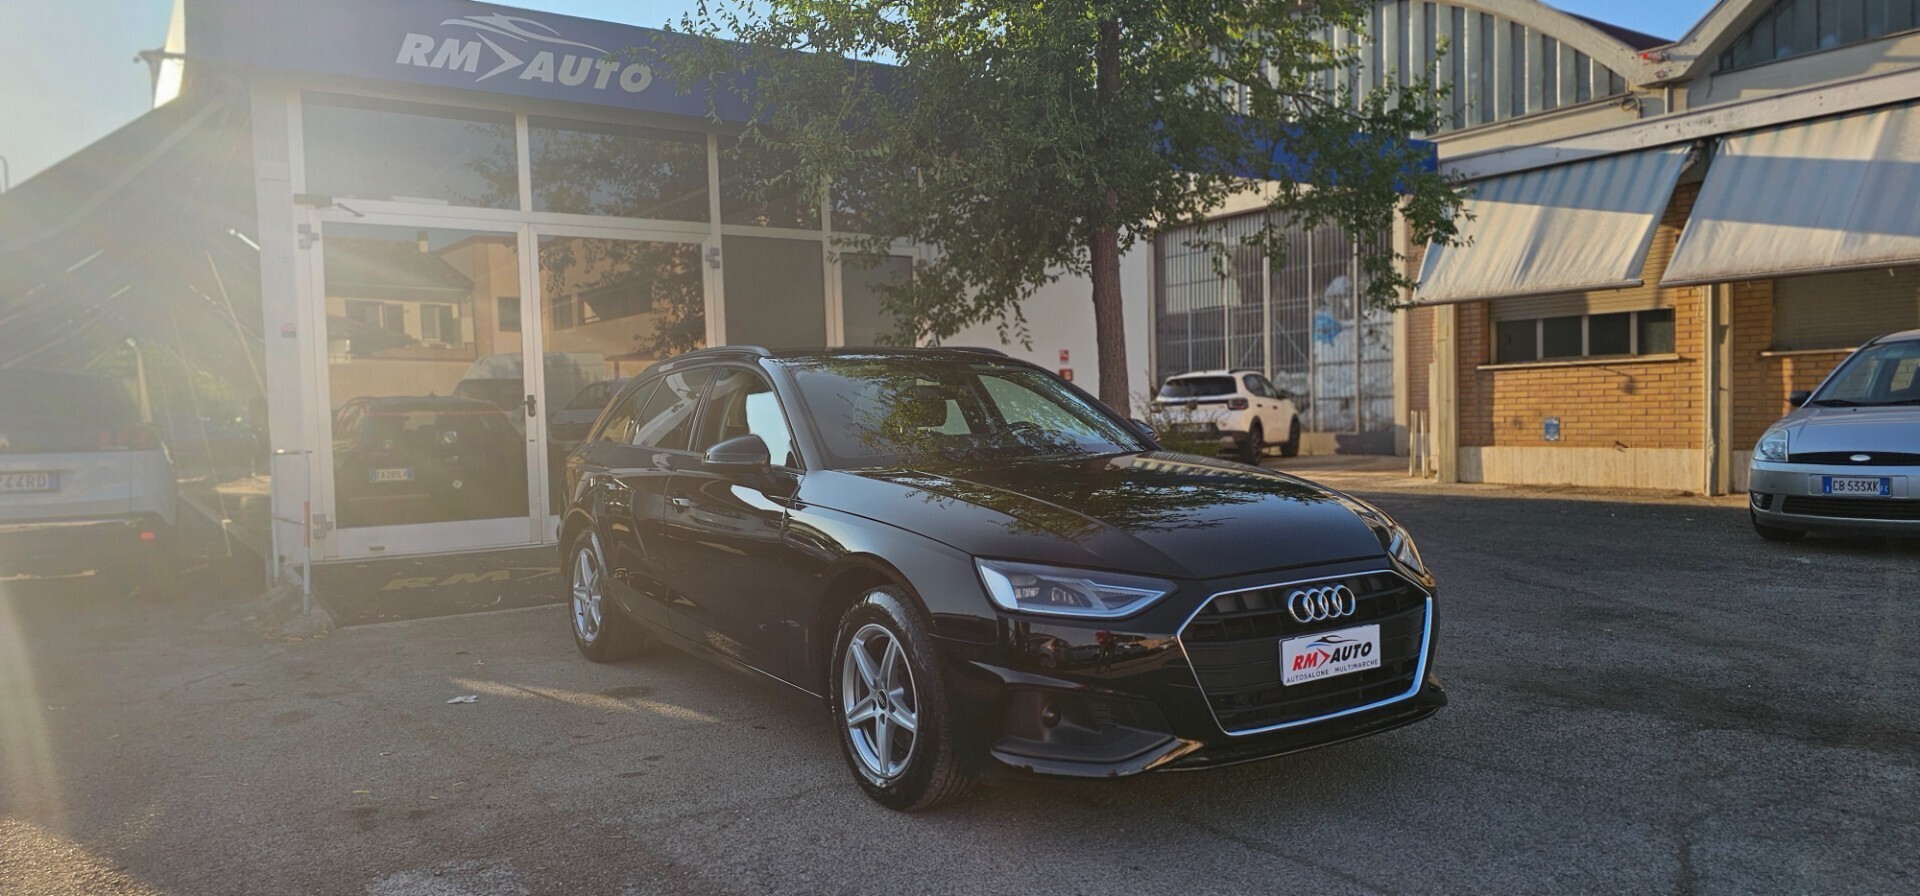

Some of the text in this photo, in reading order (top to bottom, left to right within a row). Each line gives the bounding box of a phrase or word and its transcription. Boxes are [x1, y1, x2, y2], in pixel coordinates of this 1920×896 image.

[395, 32, 653, 93] RM AUTO
[1833, 480, 1845, 491] CB
[1847, 480, 1879, 492] 533XK
[1292, 641, 1373, 671] RM AUTO
[1286, 658, 1379, 684] AUTOSALONE MULTIMARCHE
